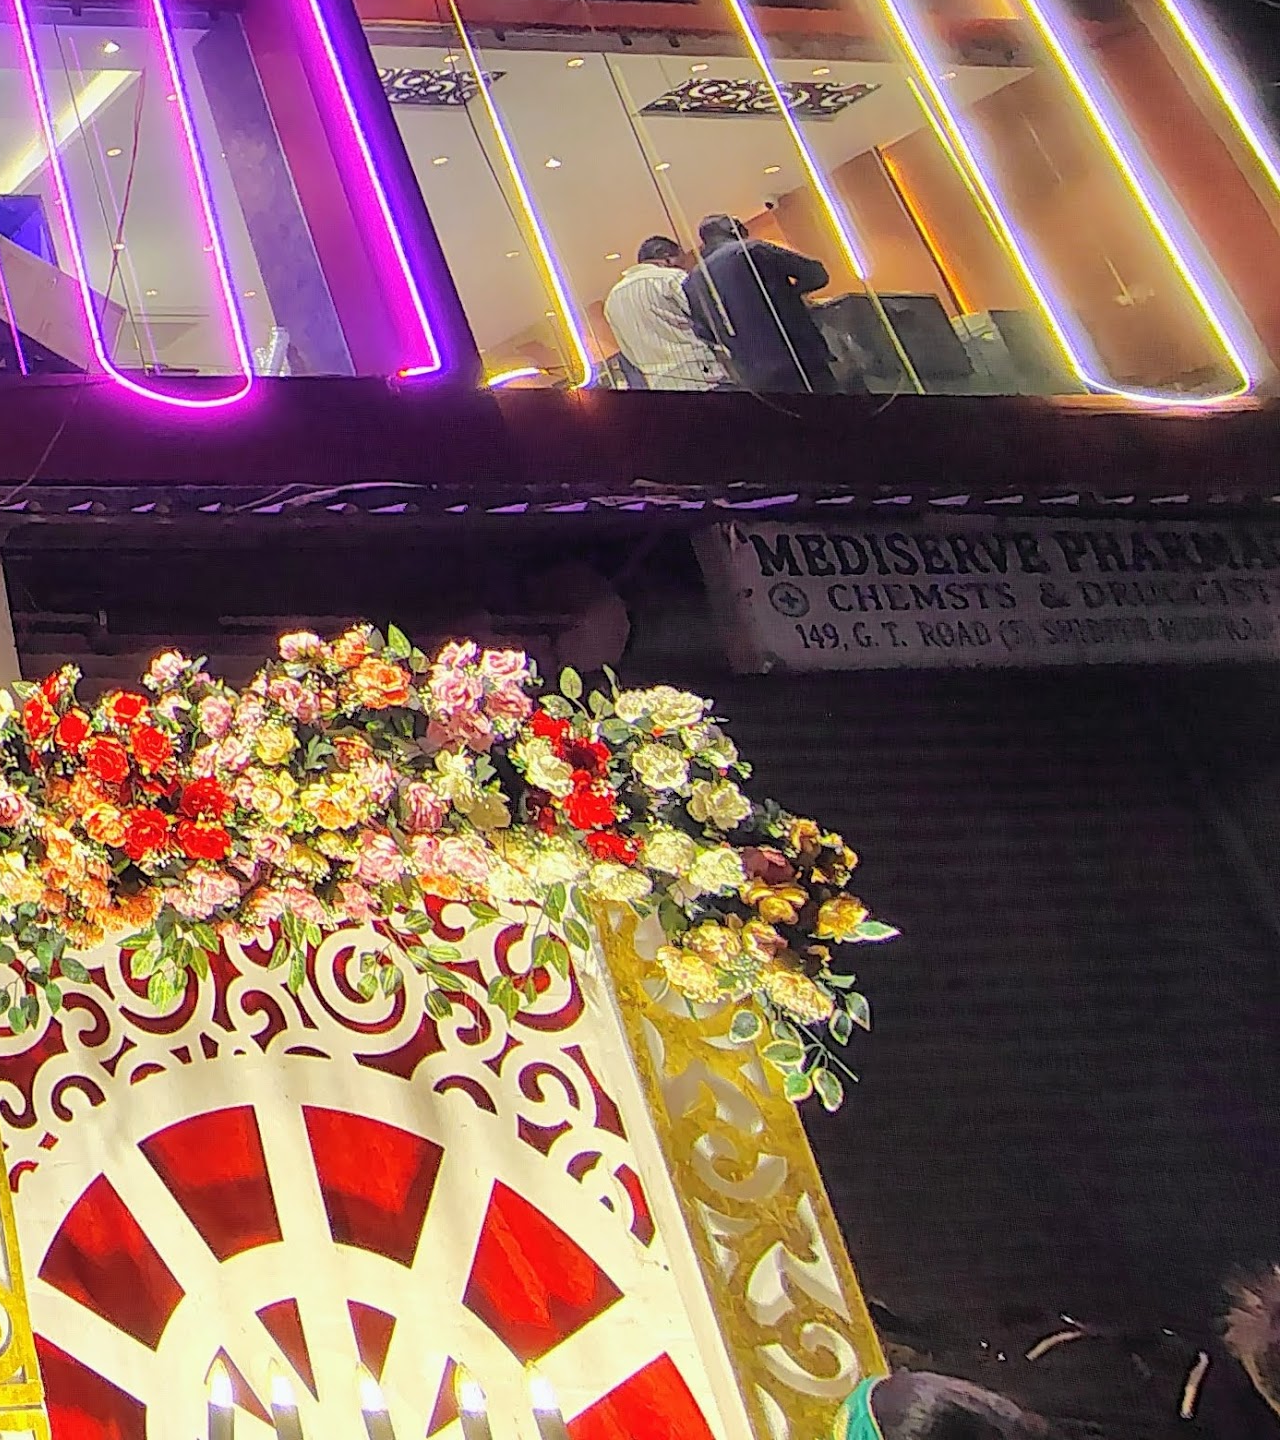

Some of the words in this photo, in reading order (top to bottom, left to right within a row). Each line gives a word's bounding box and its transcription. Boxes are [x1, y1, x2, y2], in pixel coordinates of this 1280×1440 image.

[748, 532, 1051, 577] MEDISERVE
[1040, 581, 1071, 609] &
[795, 621, 849, 652] 149,
[915, 620, 992, 649] ROAD
